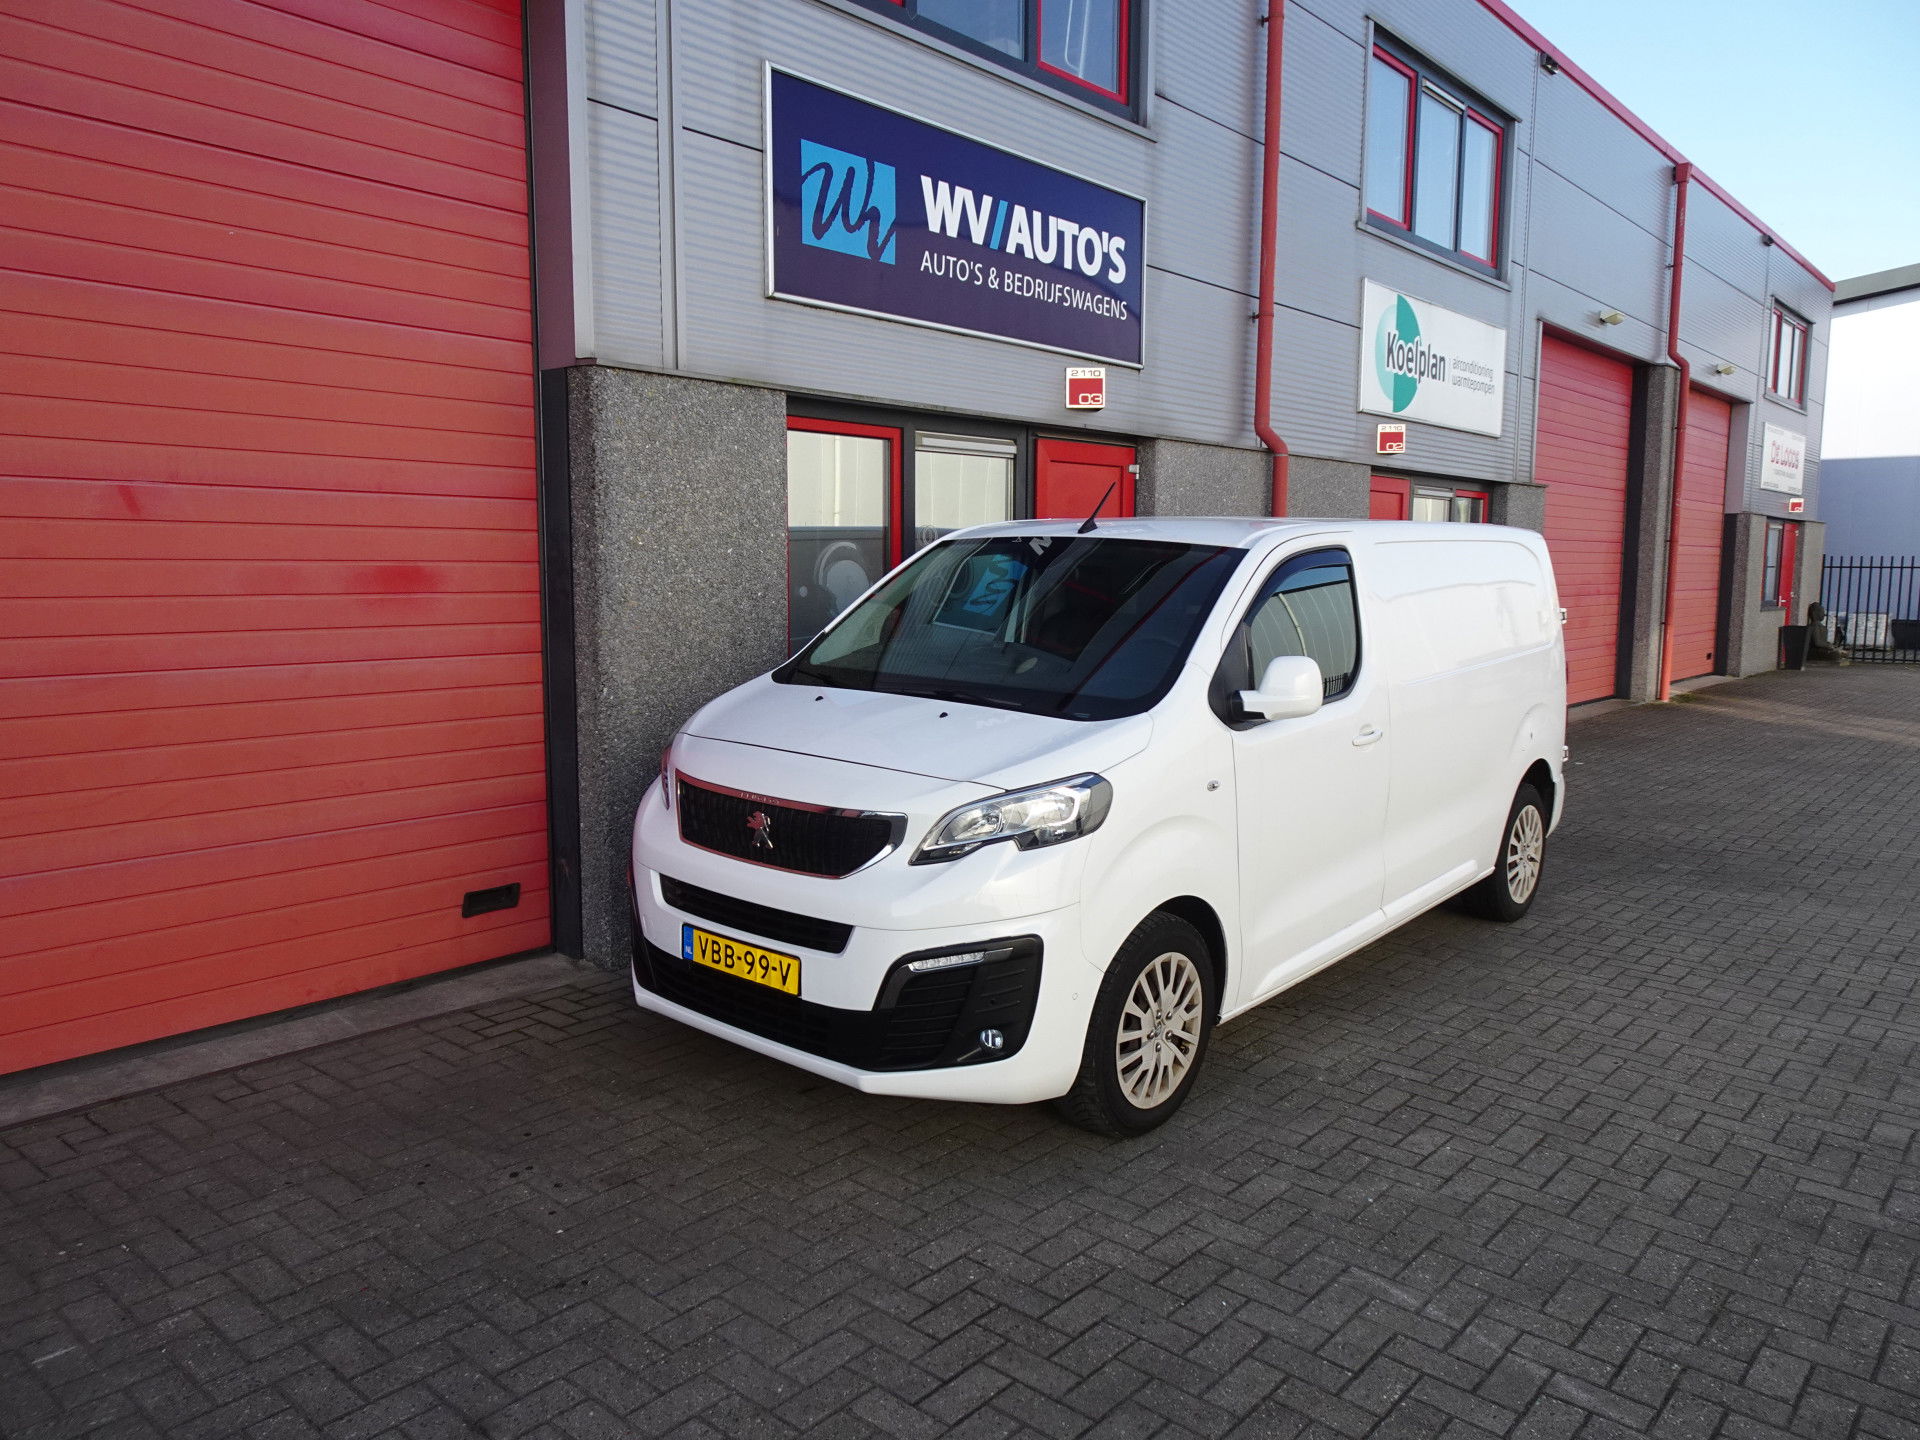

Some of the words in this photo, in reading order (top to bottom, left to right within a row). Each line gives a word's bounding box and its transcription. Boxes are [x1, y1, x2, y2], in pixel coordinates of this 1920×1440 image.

[920, 250, 984, 286] AUTO'S
[988, 267, 1000, 290] &
[1004, 270, 1128, 321] BEDRIJFSWAGENS
[1386, 331, 1446, 384] Koelplan
[1070, 369, 1102, 377] 2110
[1452, 358, 1494, 382] airconditioning
[1451, 374, 1496, 395] warmtepompen
[1078, 393, 1104, 405] 03
[1385, 442, 1404, 451] 02
[698, 935, 792, 987] VBB-99-V
